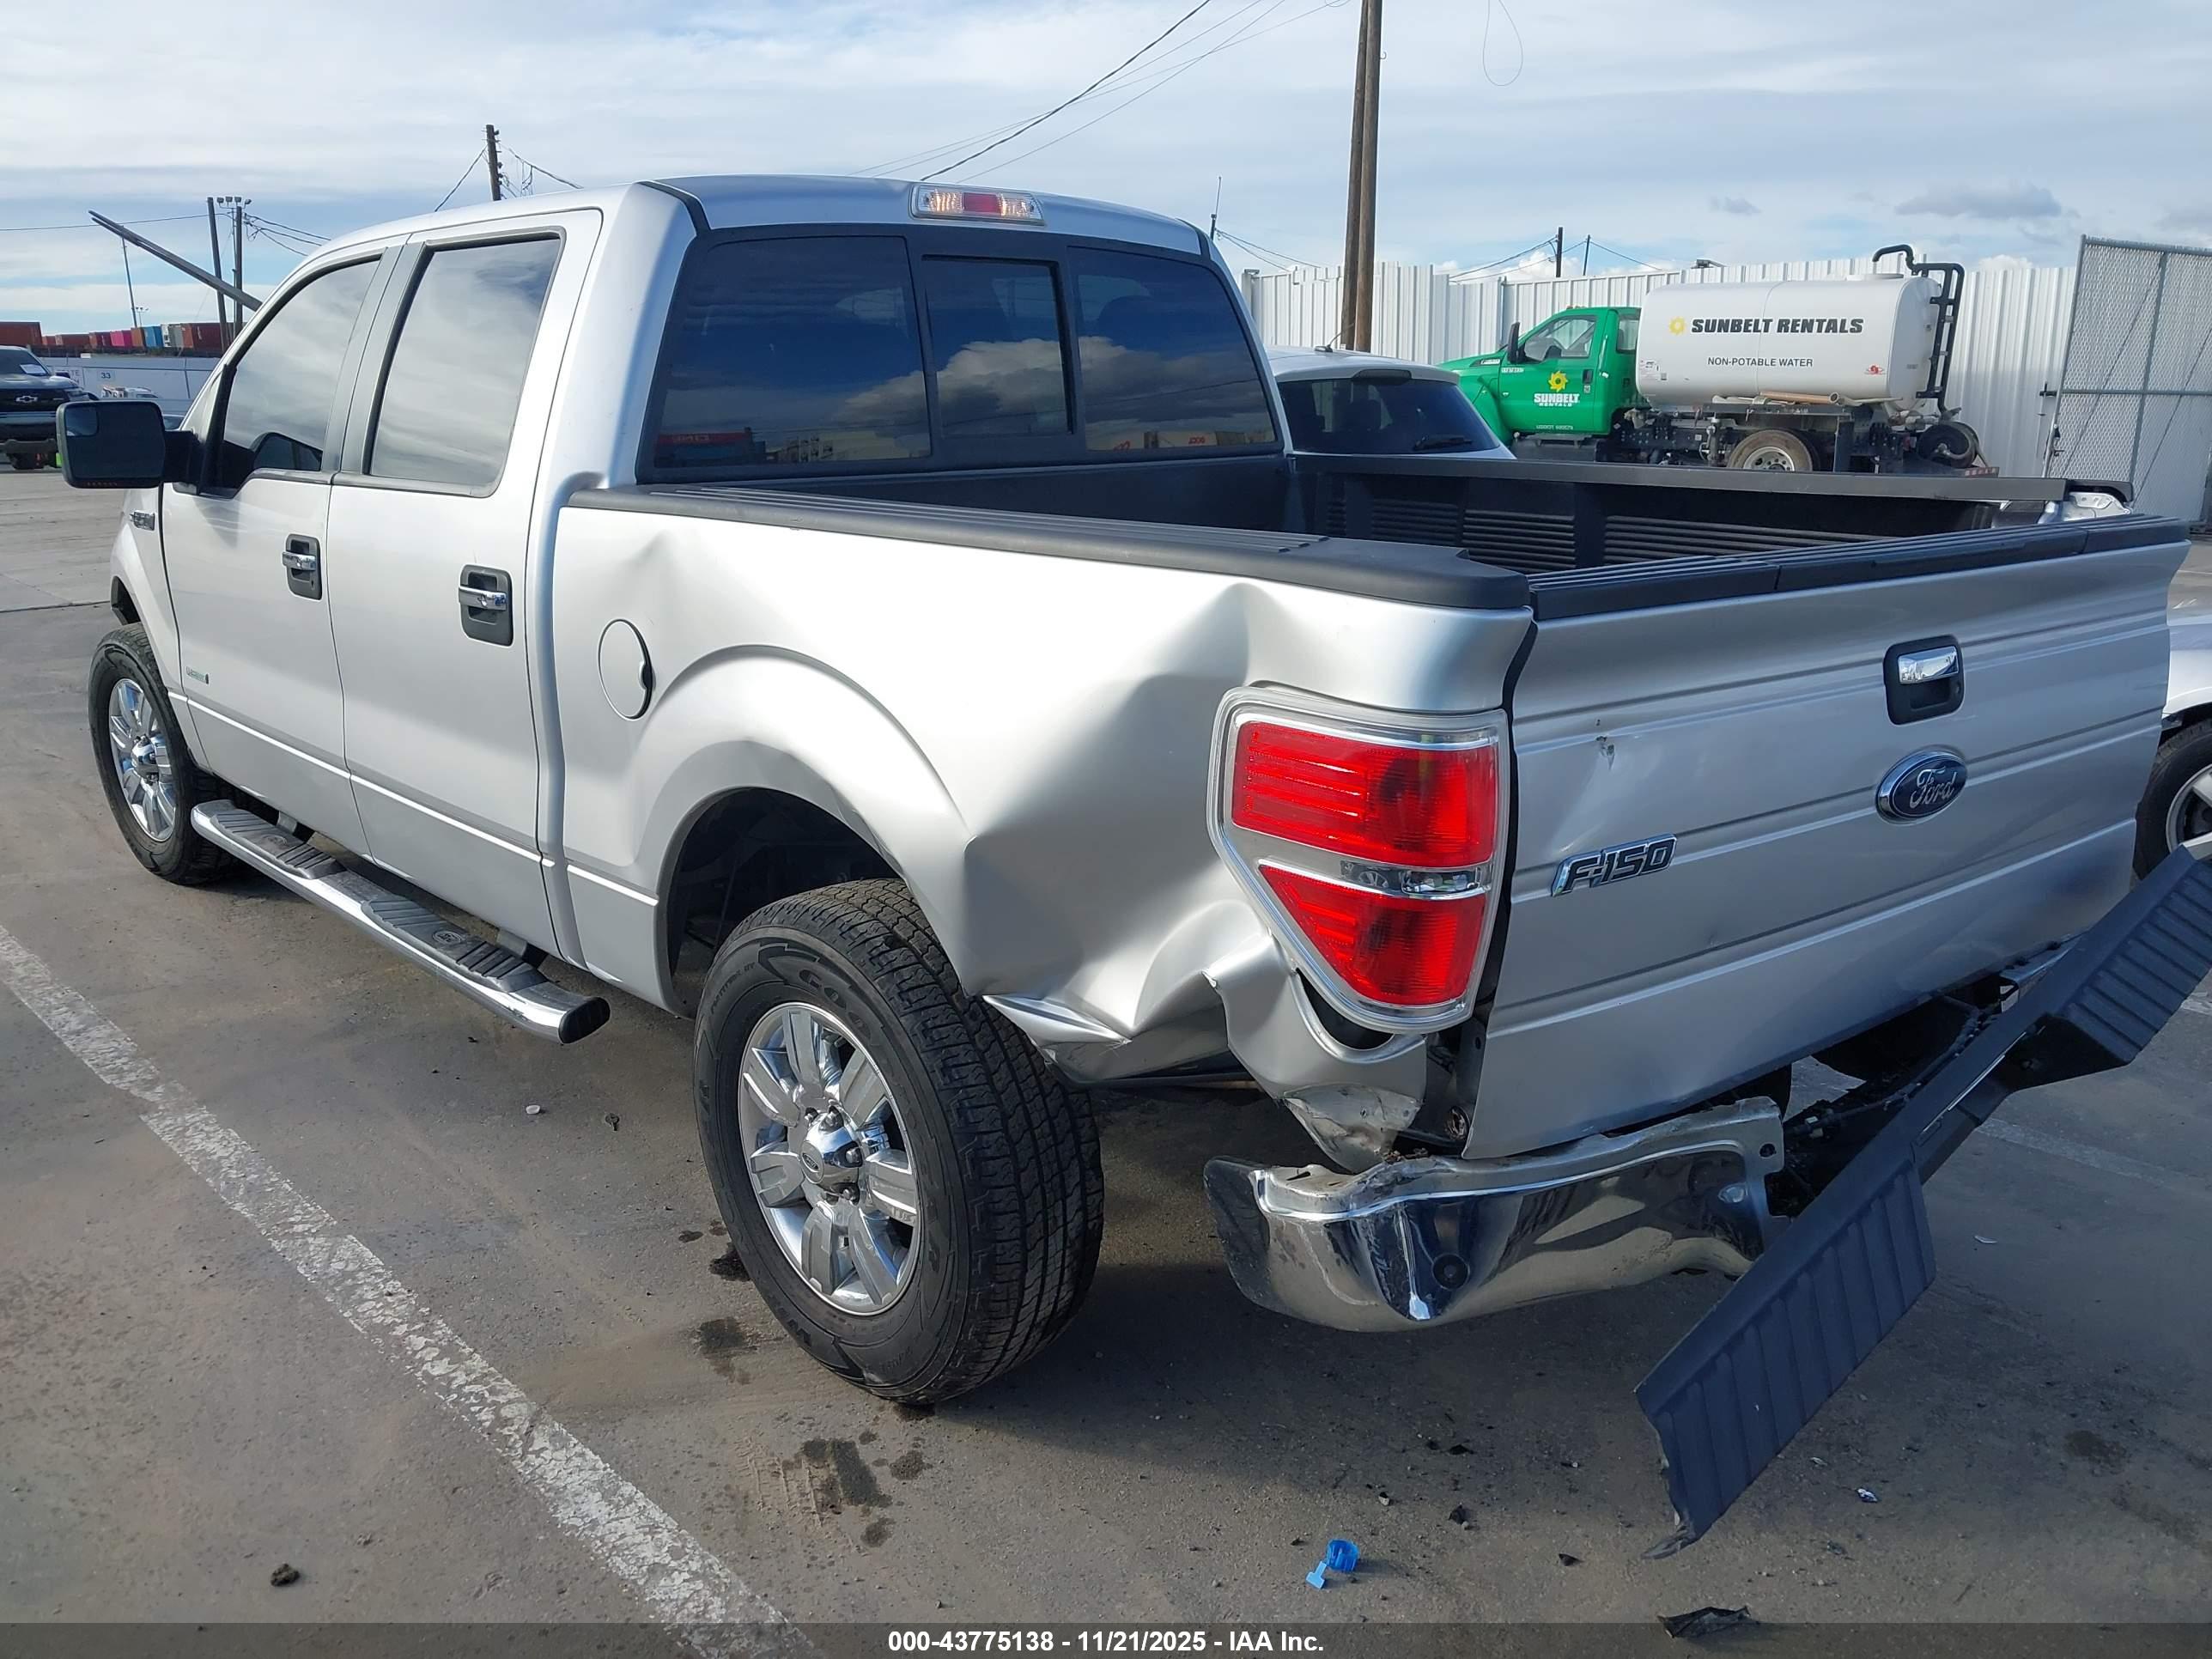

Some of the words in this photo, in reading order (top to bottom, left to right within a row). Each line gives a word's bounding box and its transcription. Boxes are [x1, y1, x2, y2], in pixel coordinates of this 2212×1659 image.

[1692, 319, 1772, 333] SUNBELT
[1777, 319, 1863, 333] RENTALS
[1707, 357, 1777, 367] NON-POTABLE
[1778, 358, 1814, 368] WATER
[1534, 393, 1580, 403] SUNBELT
[1909, 765, 1958, 809] Ford
[1551, 833, 1677, 896] F-150
